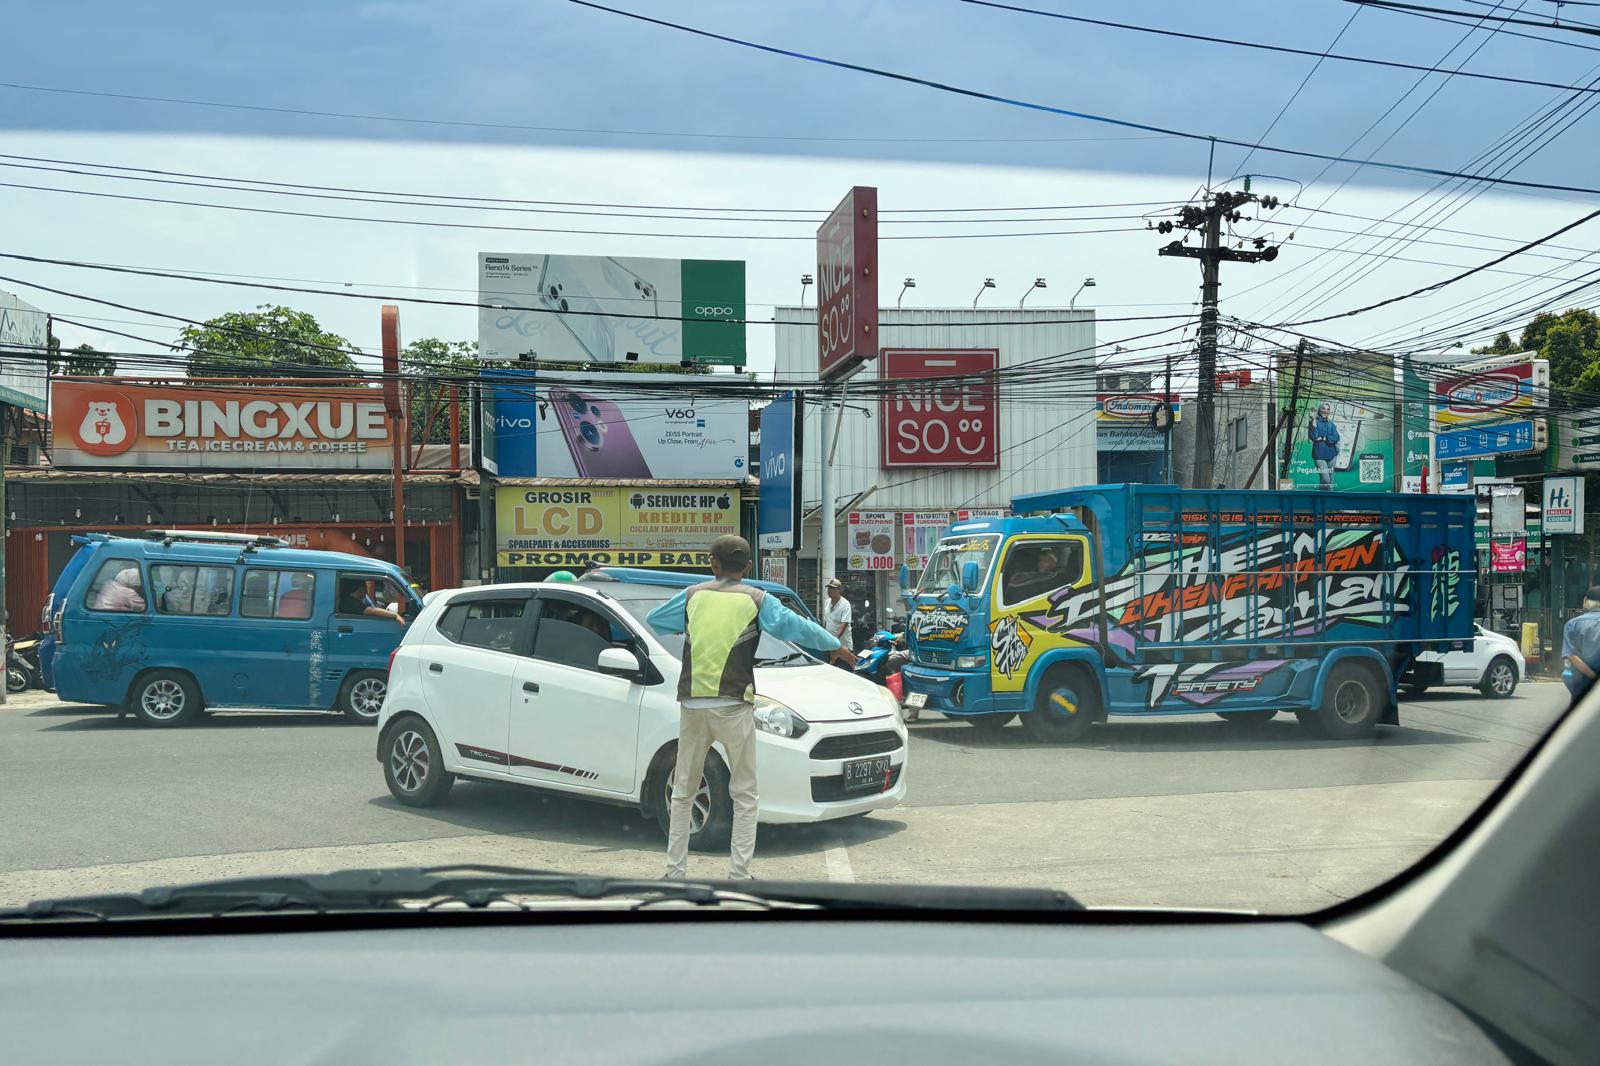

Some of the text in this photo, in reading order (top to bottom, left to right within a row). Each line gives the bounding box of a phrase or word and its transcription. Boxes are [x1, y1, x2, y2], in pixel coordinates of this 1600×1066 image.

[485, 264, 510, 272] Reno14
[695, 306, 734, 318] oppo
[896, 378, 986, 413] NICE
[144, 399, 388, 440] BINGXUE
[665, 408, 696, 419] V60
[232, 440, 292, 452] CREAM
[295, 440, 305, 452] &
[309, 440, 368, 453] COFFEE
[765, 451, 786, 480] vivo
[525, 491, 592, 504] GROSIR
[647, 495, 716, 508] SERVICE HP
[1550, 487, 1570, 508] Hi
[514, 506, 603, 536] LCD
[638, 511, 723, 524] KREDIT HP
[630, 525, 736, 533] CICILAN TANPA KARTU KREDIT
[508, 539, 610, 549] SPAREPART & ACCESORISS
[508, 552, 712, 565] PROMO HP BAR
[865, 556, 893, 569] 1.000
[846, 763, 852, 780] B
[855, 761, 873, 778] 2297
